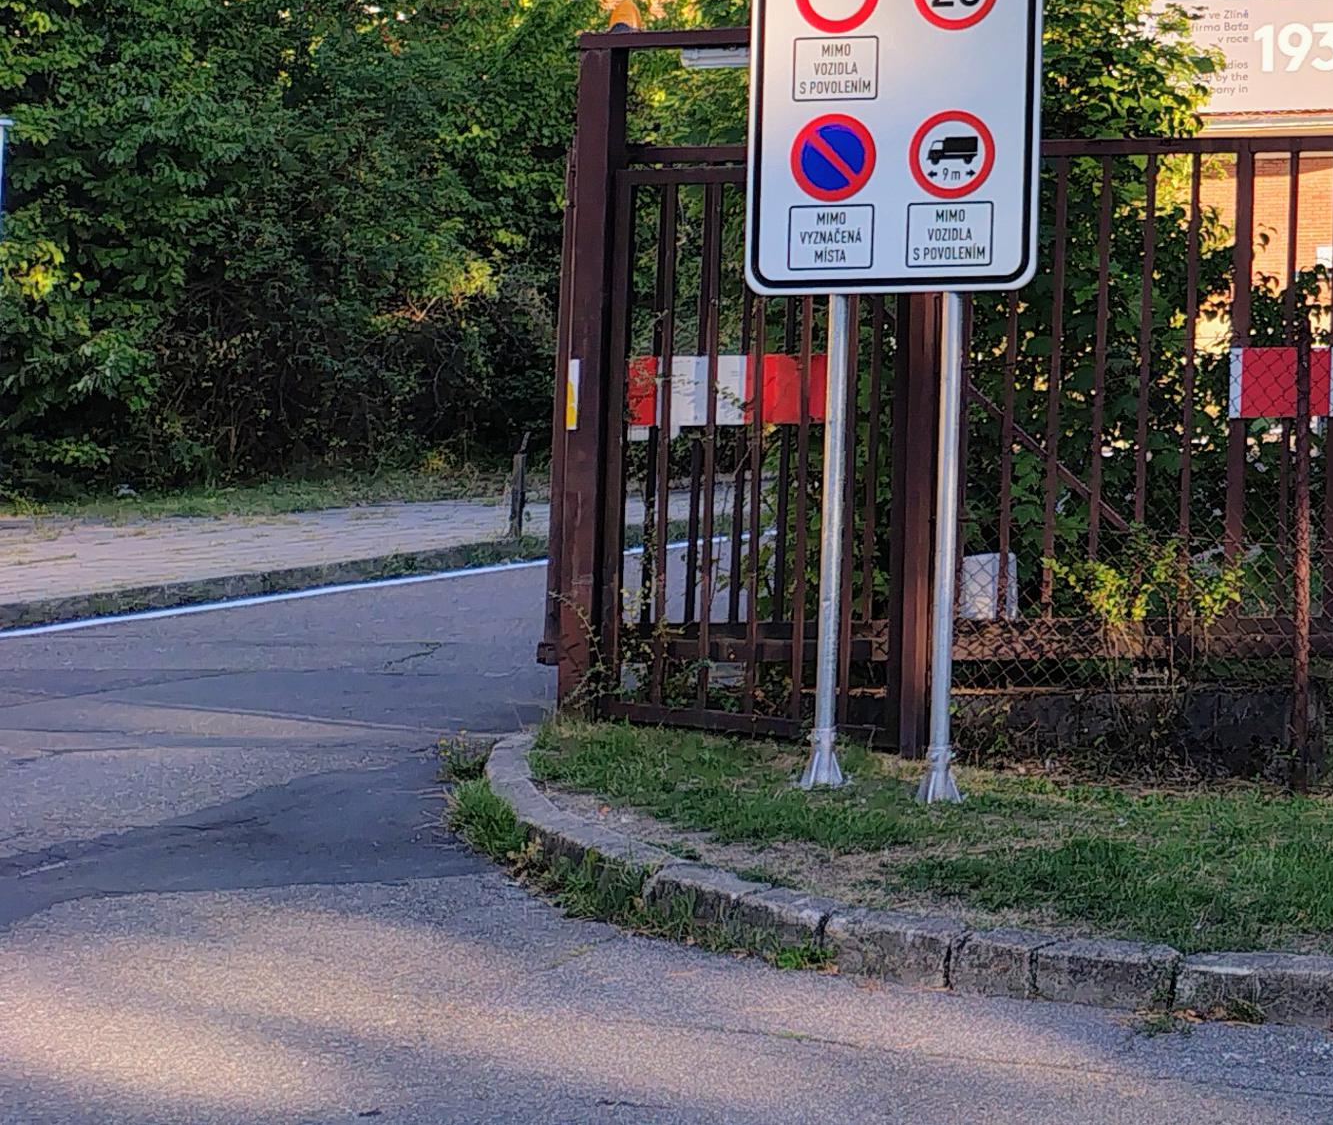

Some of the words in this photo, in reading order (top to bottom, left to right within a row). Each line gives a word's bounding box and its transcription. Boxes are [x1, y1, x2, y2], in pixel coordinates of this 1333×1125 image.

[1190, 23, 1221, 33] firma
[1223, 22, 1249, 32] Baťa
[1226, 35, 1249, 44] roce
[821, 43, 851, 58] MIMO
[814, 62, 858, 76] VOZIDLA
[1231, 71, 1249, 81] the
[799, 81, 807, 95] S
[810, 77, 871, 94] POVOLENÍM
[1239, 84, 1248, 94] in
[942, 167, 950, 182] 9
[951, 171, 961, 182] m
[817, 211, 846, 225] MIMO
[936, 209, 966, 223] MIMO
[800, 227, 862, 245] VYZNAČENÁ
[927, 228, 973, 242] VOZIDLA
[814, 246, 847, 263] MÍSTA
[913, 247, 921, 261] S
[923, 244, 986, 261] POVOLENÍM
